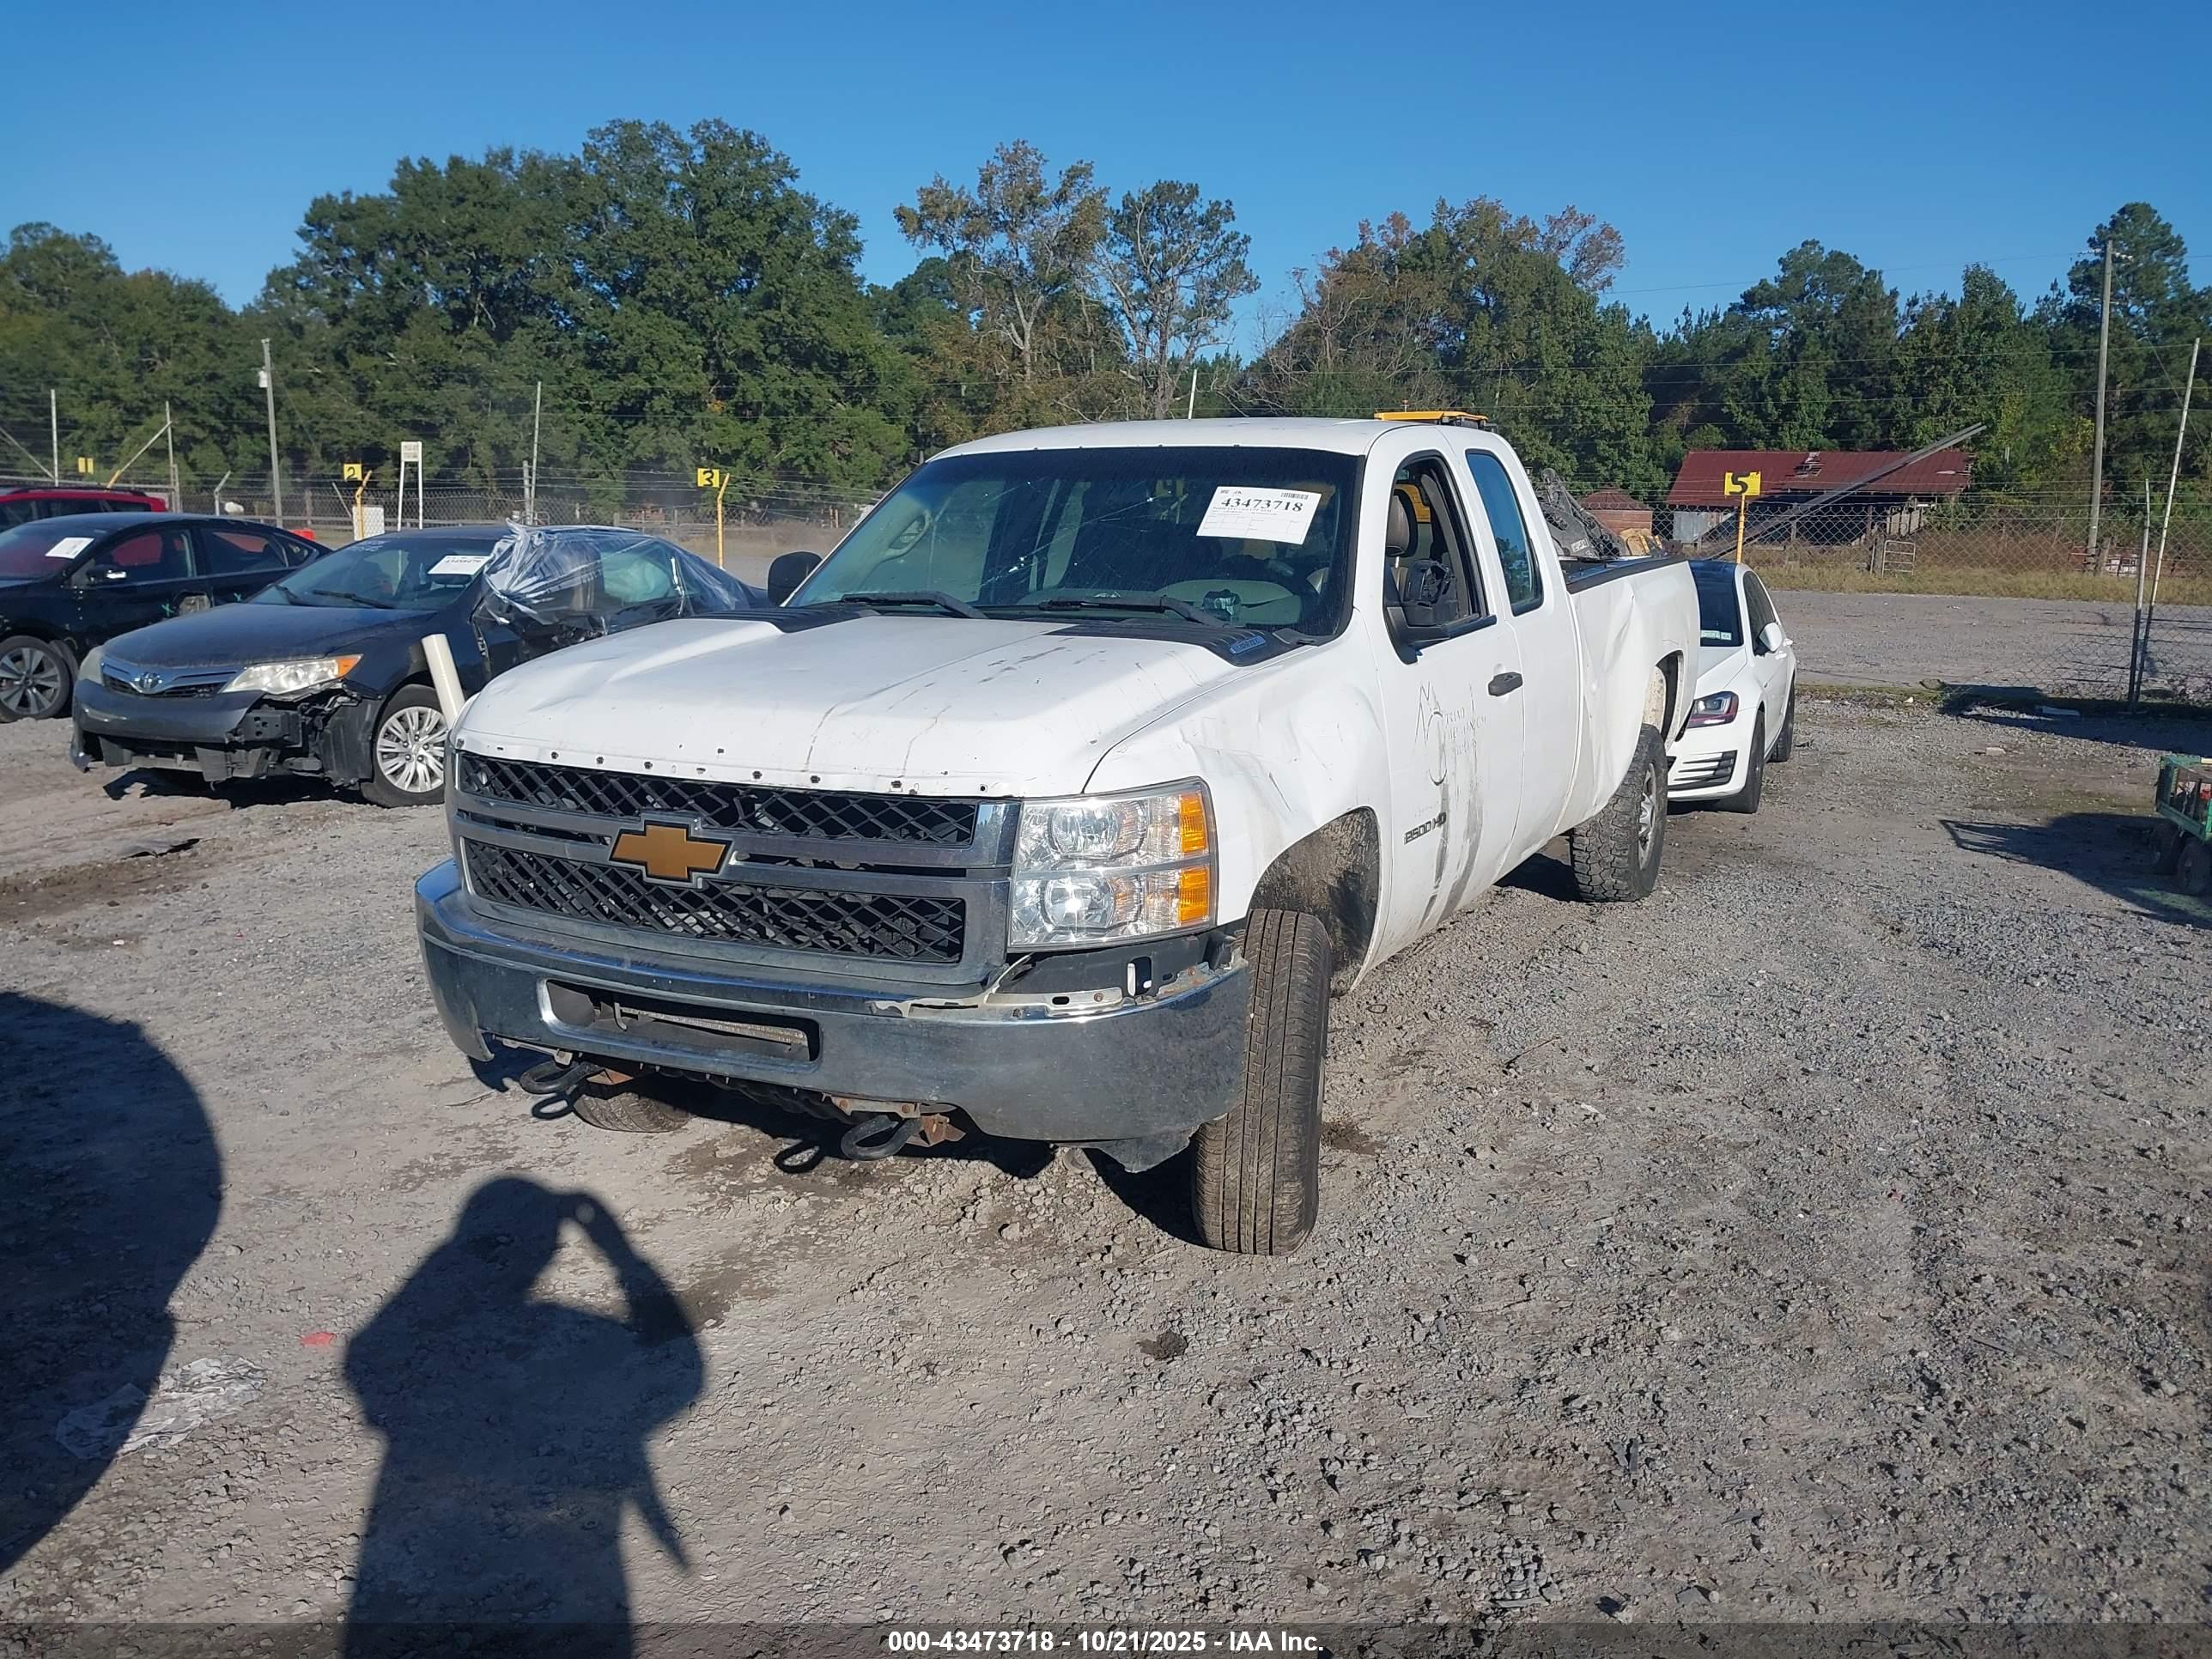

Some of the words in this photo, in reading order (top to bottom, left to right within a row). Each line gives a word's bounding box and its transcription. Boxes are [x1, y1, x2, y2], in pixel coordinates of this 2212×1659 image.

[345, 466, 358, 481] 2
[702, 470, 714, 487] 3
[1729, 471, 1751, 495] 5
[1220, 497, 1304, 513] 43473718
